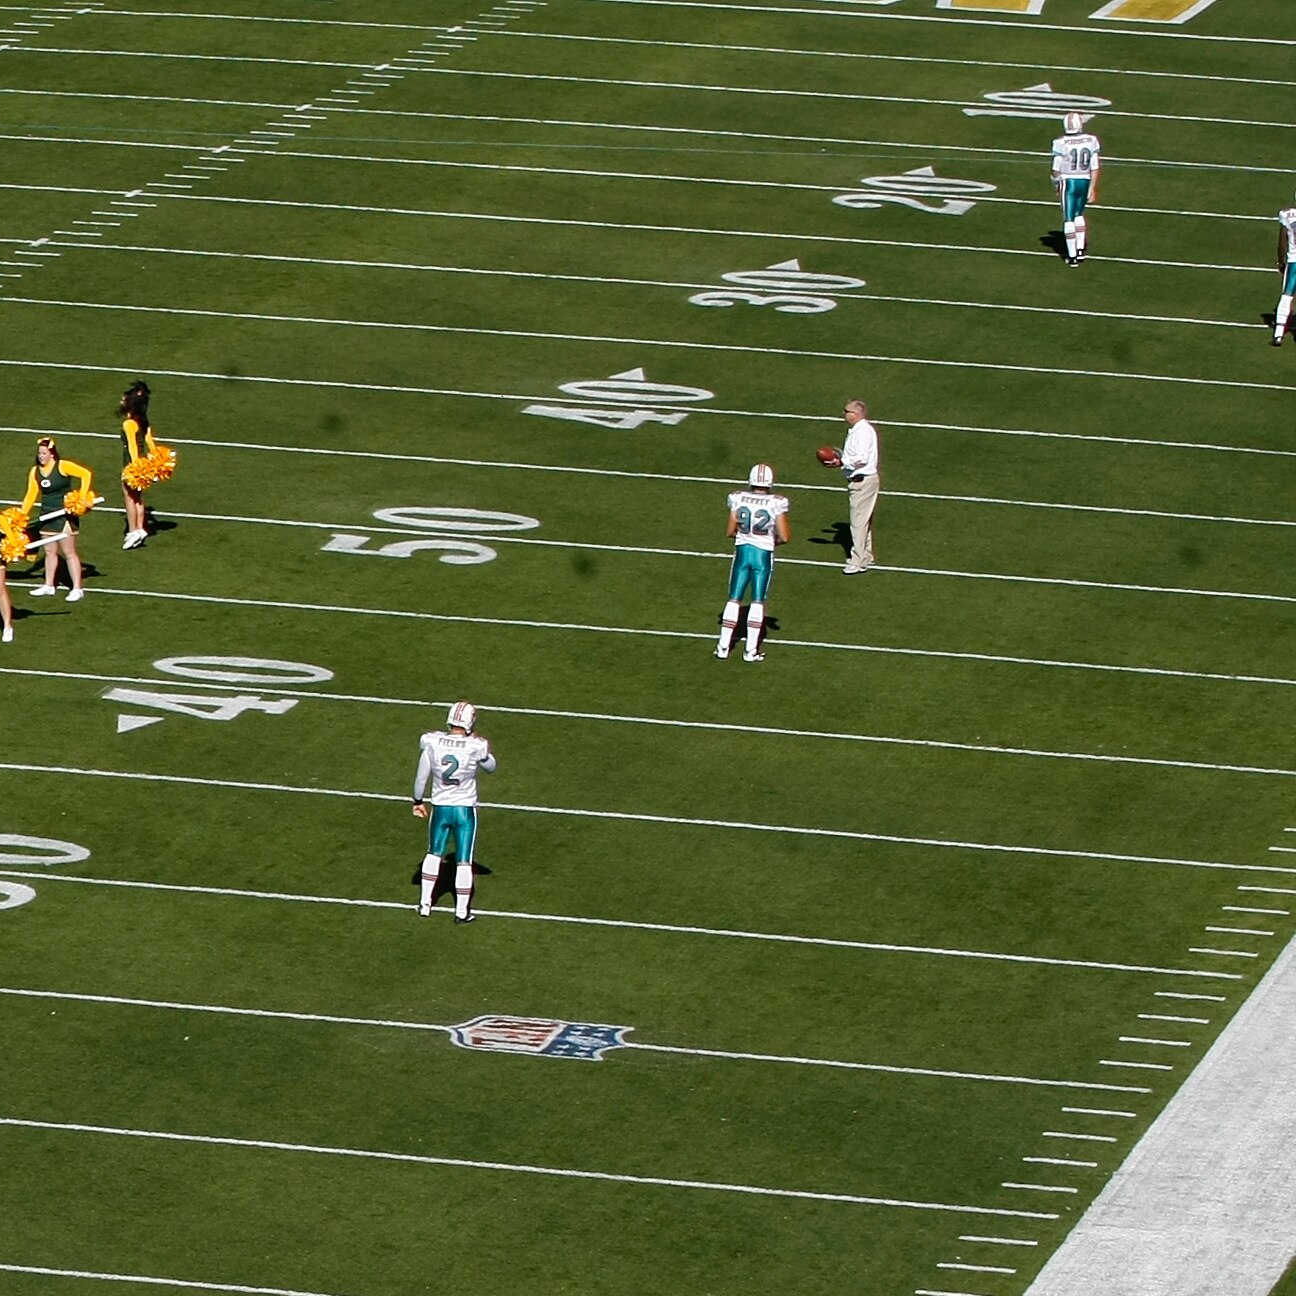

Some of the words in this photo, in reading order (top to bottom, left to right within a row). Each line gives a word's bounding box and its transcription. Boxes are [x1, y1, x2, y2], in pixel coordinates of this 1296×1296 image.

[1070, 147, 1091, 170] 10
[832, 175, 997, 216] 20
[688, 267, 866, 314] 30
[521, 379, 714, 429] 40
[320, 506, 541, 565] 50
[737, 506, 770, 535] 92
[102, 655, 334, 721] 40
[443, 754, 462, 785] 2
